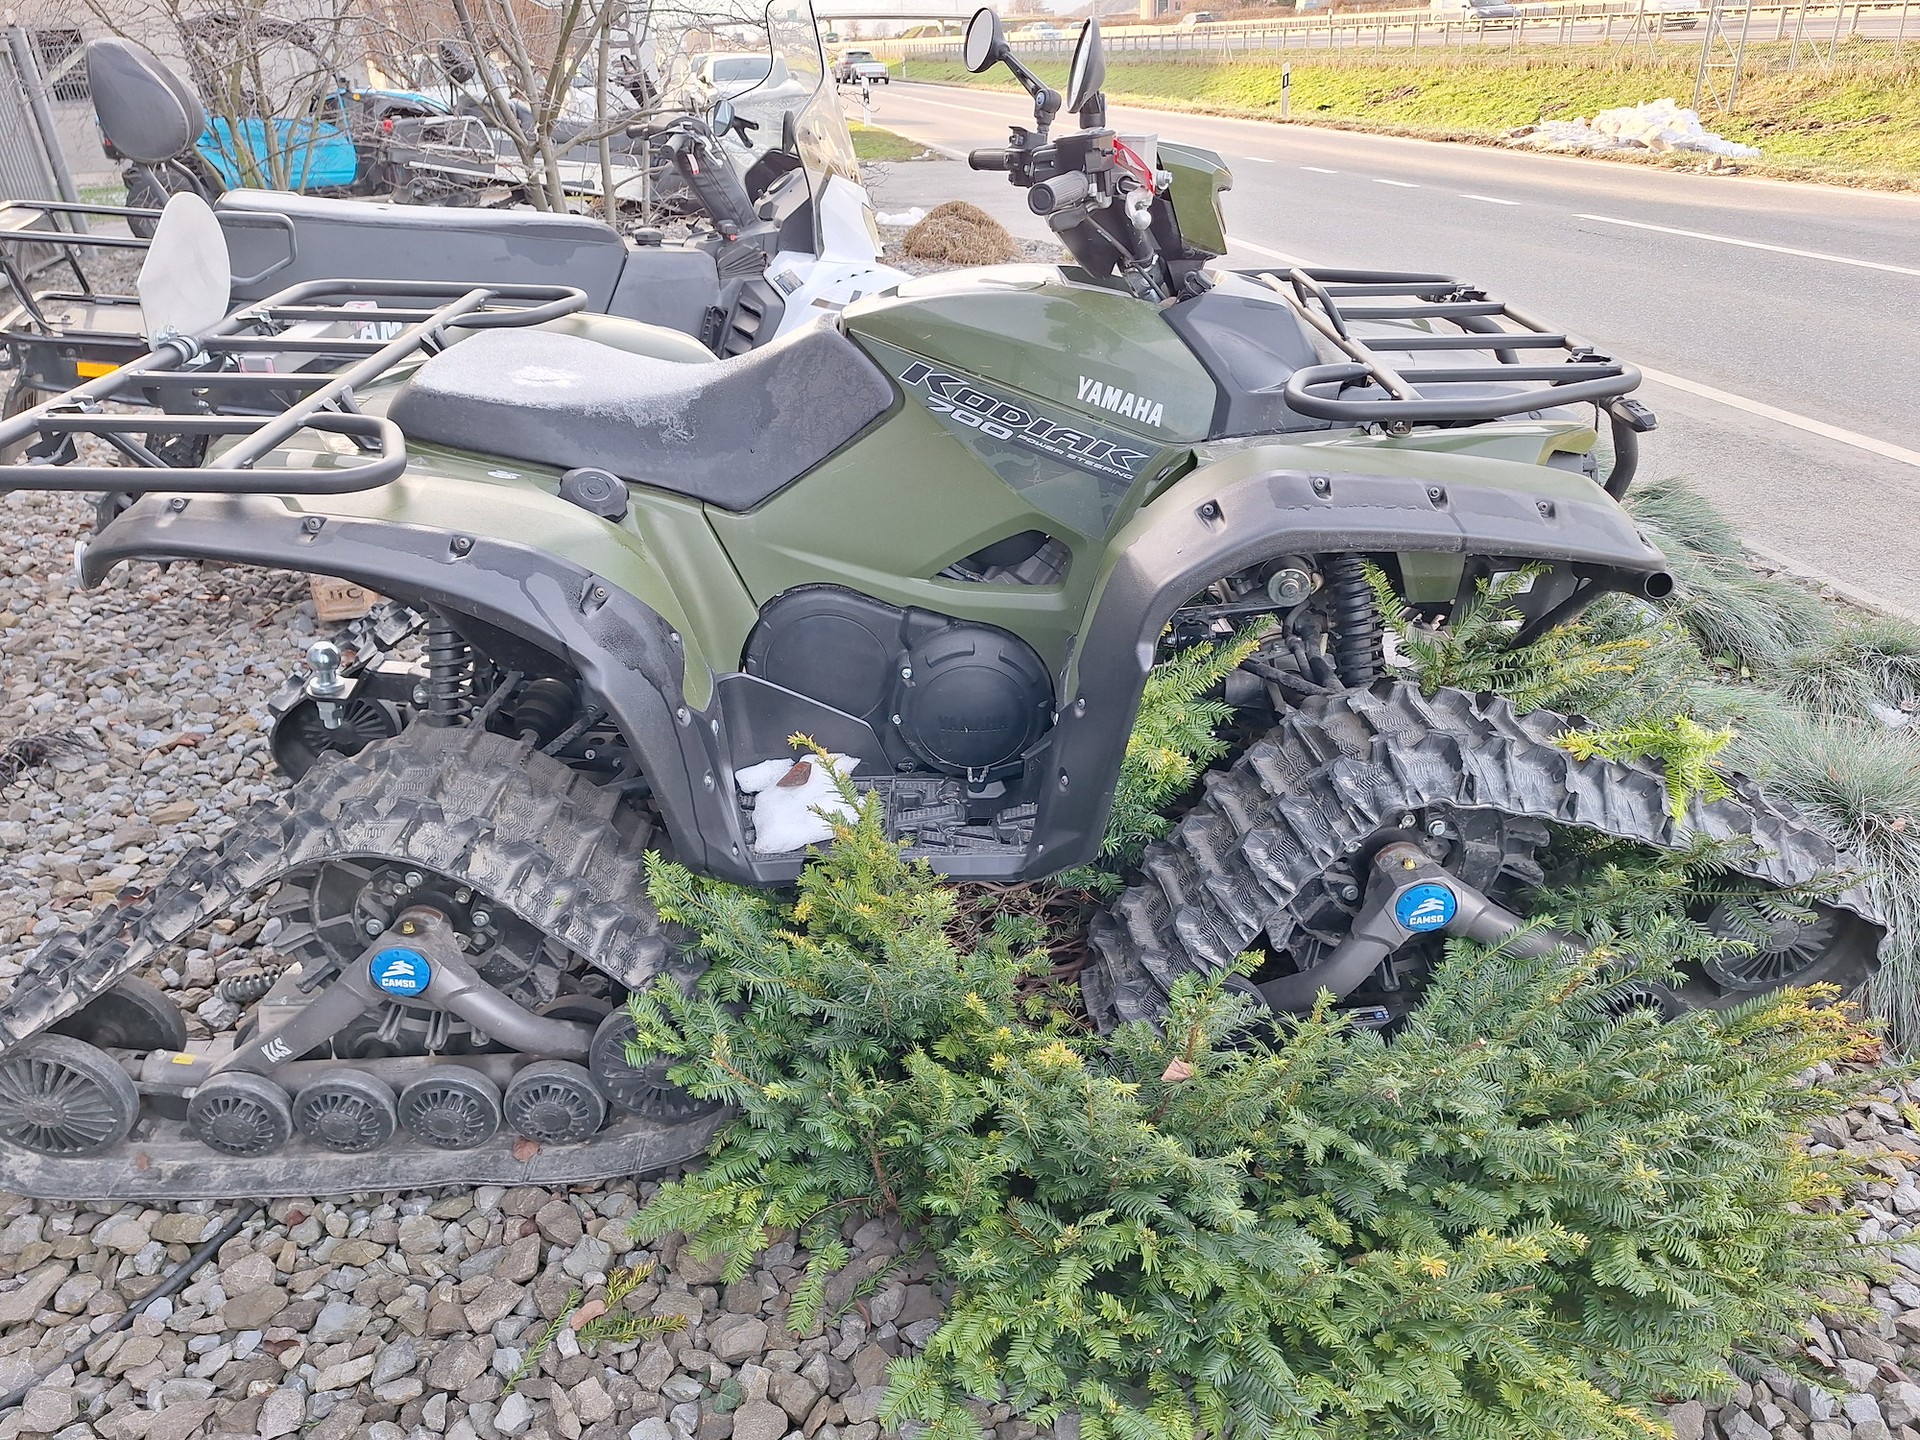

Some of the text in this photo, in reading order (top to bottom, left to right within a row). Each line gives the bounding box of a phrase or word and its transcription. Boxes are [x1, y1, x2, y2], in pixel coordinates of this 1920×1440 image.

[898, 361, 1150, 471] KODIAK
[925, 396, 1014, 441] 700
[1076, 375, 1164, 428] YAMAHA
[1017, 434, 1135, 480] POWER STEERING
[1409, 914, 1444, 925] CAMSO
[381, 978, 416, 988] CAMSO
